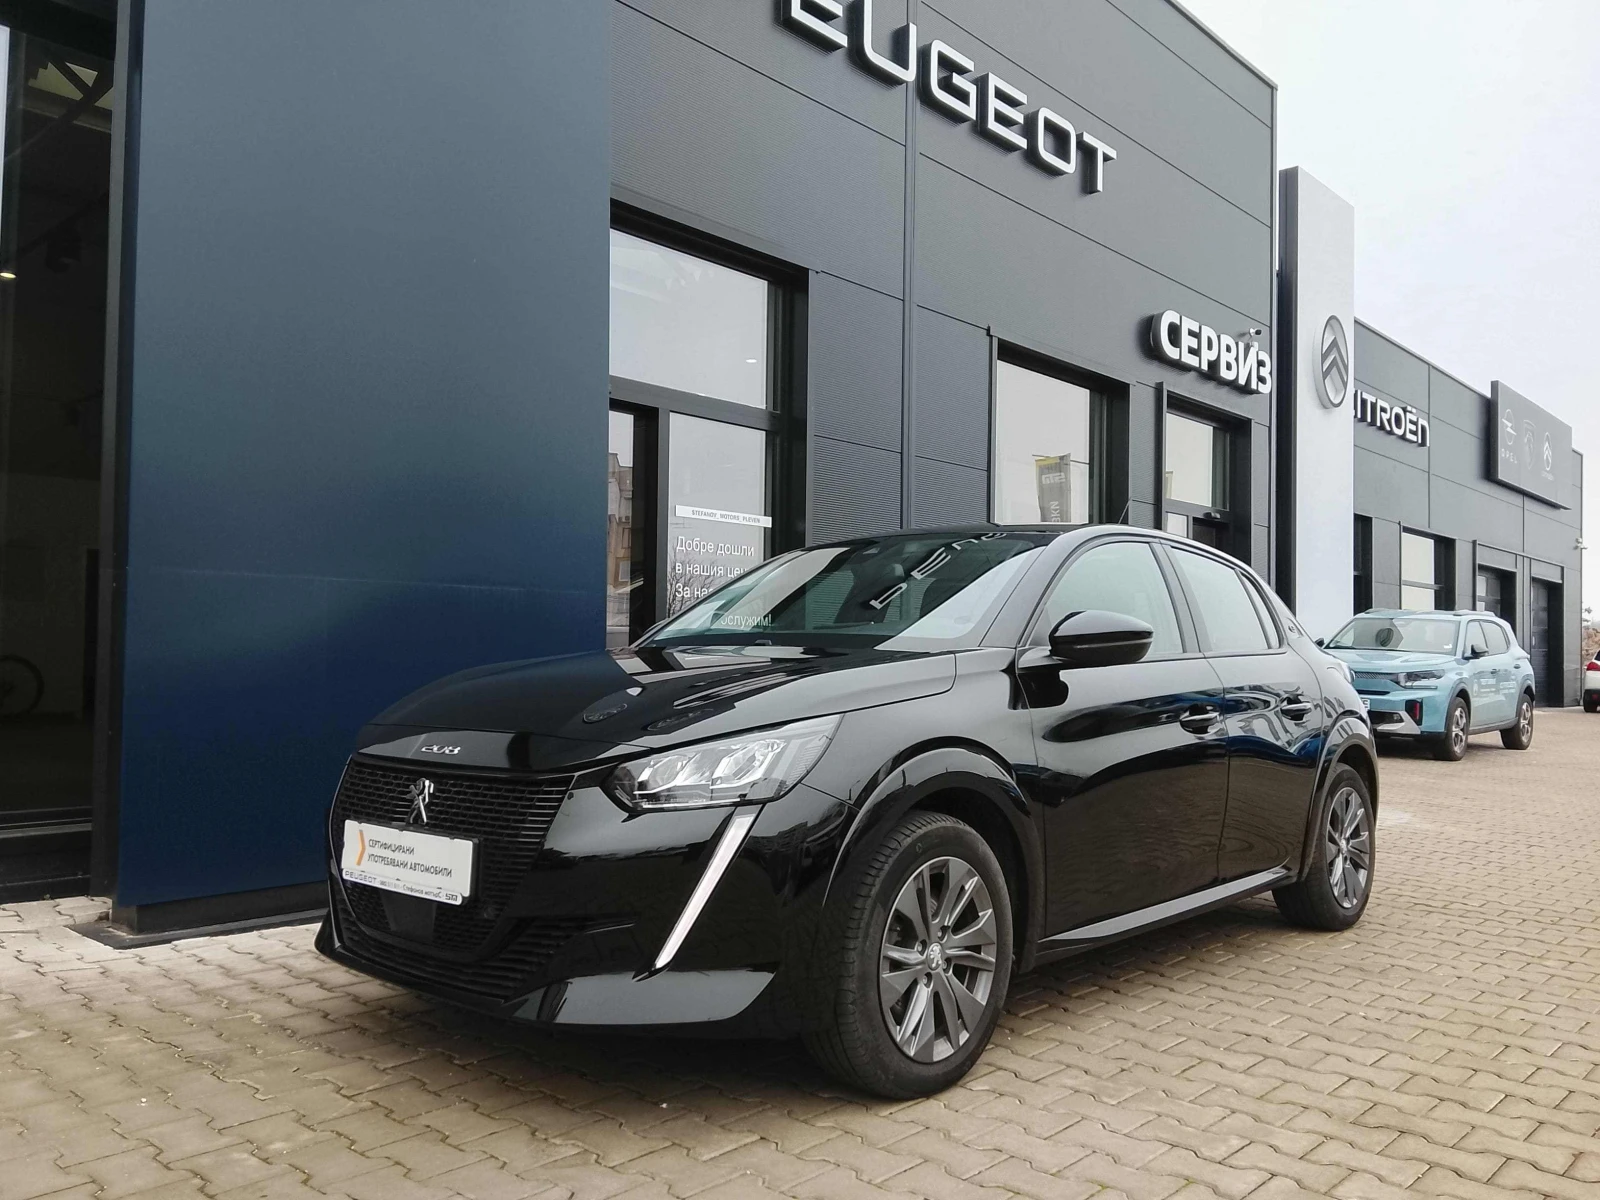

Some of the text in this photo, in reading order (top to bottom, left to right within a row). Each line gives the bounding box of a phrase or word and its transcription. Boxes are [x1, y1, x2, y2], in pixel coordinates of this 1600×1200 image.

[1160, 309, 1272, 394] СЕРВИЗ
[676, 535, 755, 557] Добре дошли
[675, 562, 683, 574] в
[686, 564, 724, 577] нашия
[675, 583, 691, 598] За
[368, 838, 415, 856] СЕРТИФИЦИРАНИ
[367, 853, 453, 878] УПОТРЕБЯВАНИ АВТОМОБИЛИ
[345, 870, 377, 883] PEUGEOT
